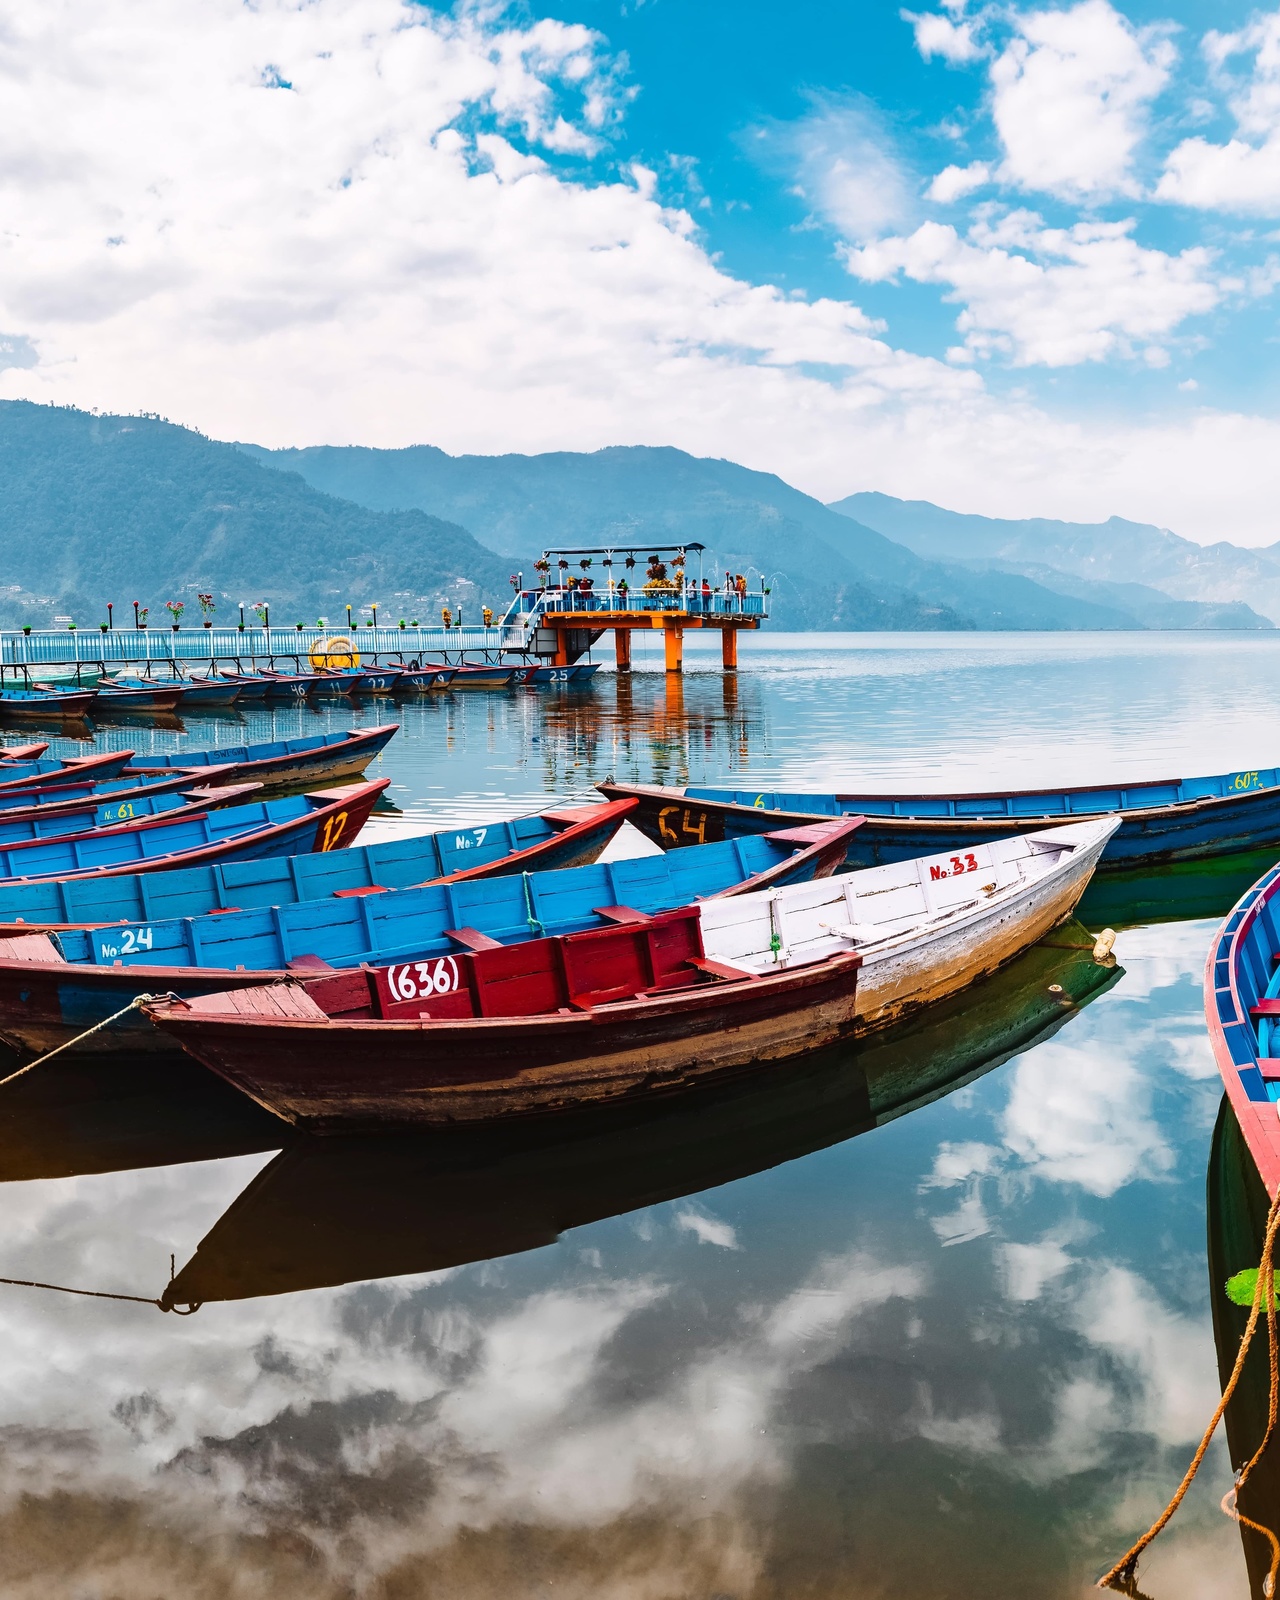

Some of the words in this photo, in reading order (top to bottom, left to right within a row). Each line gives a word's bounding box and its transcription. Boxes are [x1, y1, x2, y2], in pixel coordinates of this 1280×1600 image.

[550, 669, 568, 681] 25
[290, 683, 305, 697] 46
[1234, 771, 1259, 789] 607
[118, 803, 135, 818] 61
[120, 927, 153, 955] 24
[387, 955, 459, 1002] (636)
